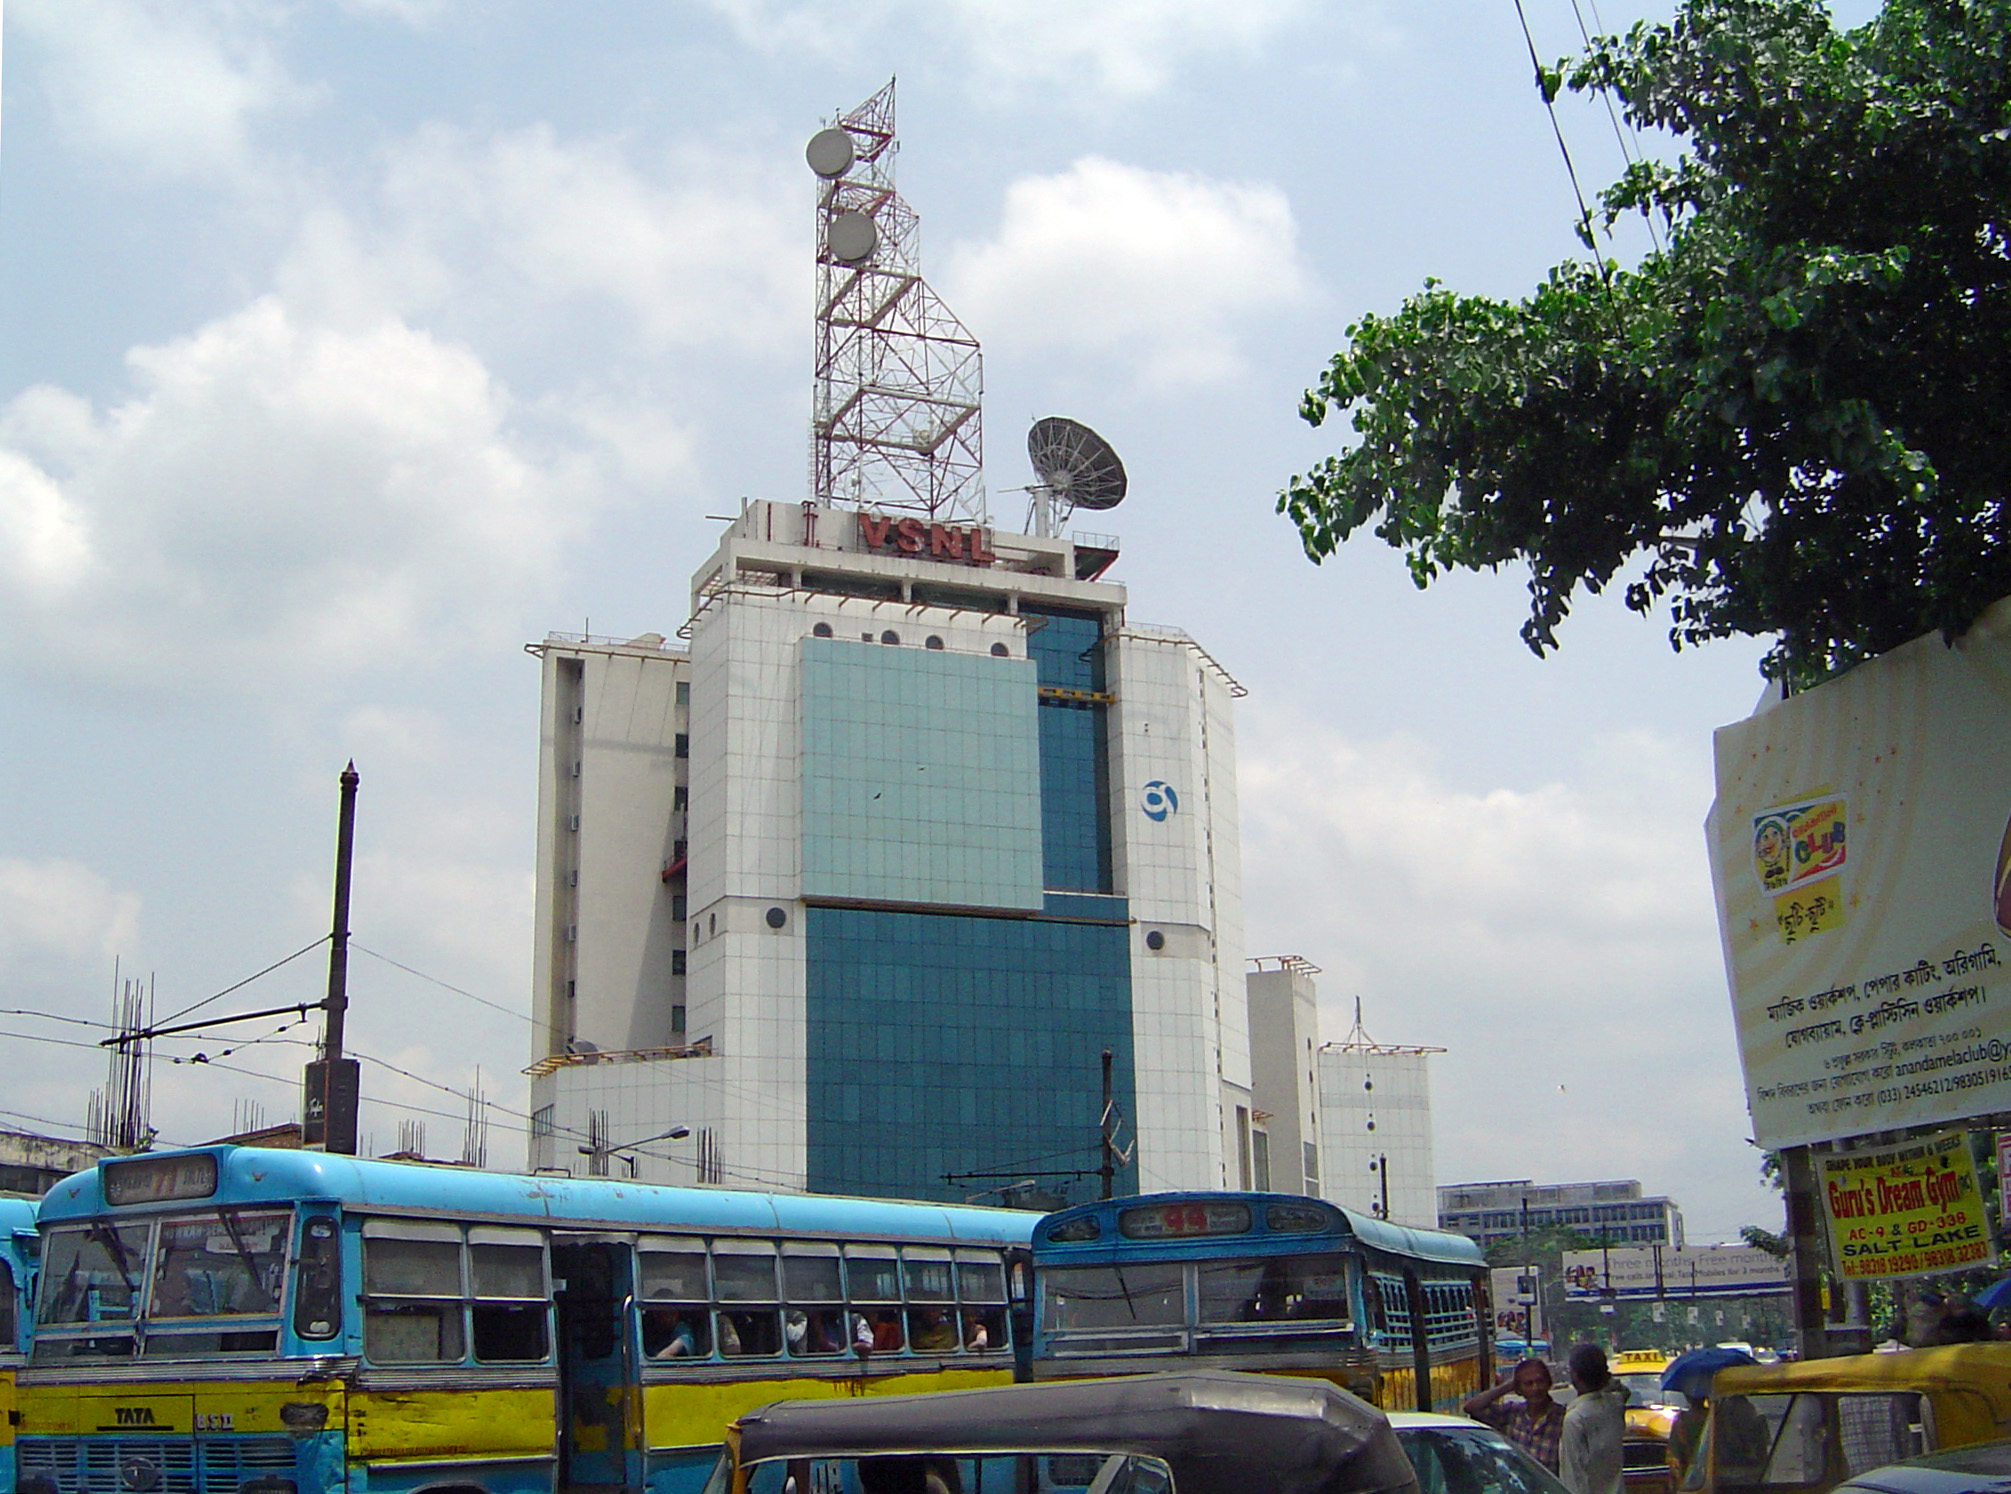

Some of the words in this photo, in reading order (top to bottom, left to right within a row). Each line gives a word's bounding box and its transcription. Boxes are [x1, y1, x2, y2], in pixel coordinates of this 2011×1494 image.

[859, 512, 995, 562] VSNL
[1795, 821, 1845, 863] CLUB
[1864, 973, 1900, 998] পেপার
[1942, 943, 2001, 976] অরিগামি,
[1877, 1087, 1901, 1107] (033)
[1934, 1134, 1961, 1154] WEEKS
[1828, 1178, 1875, 1219] Guru's
[1876, 1176, 1925, 1215] Dream
[1925, 1166, 1960, 1213] Gym
[1842, 1239, 1902, 1257] SALT
[1913, 1225, 1981, 1248] LAKE
[1699, 1253, 1727, 1268] Free
[1624, 1353, 1657, 1361] TAXI
[115, 1408, 155, 1424] TATA
